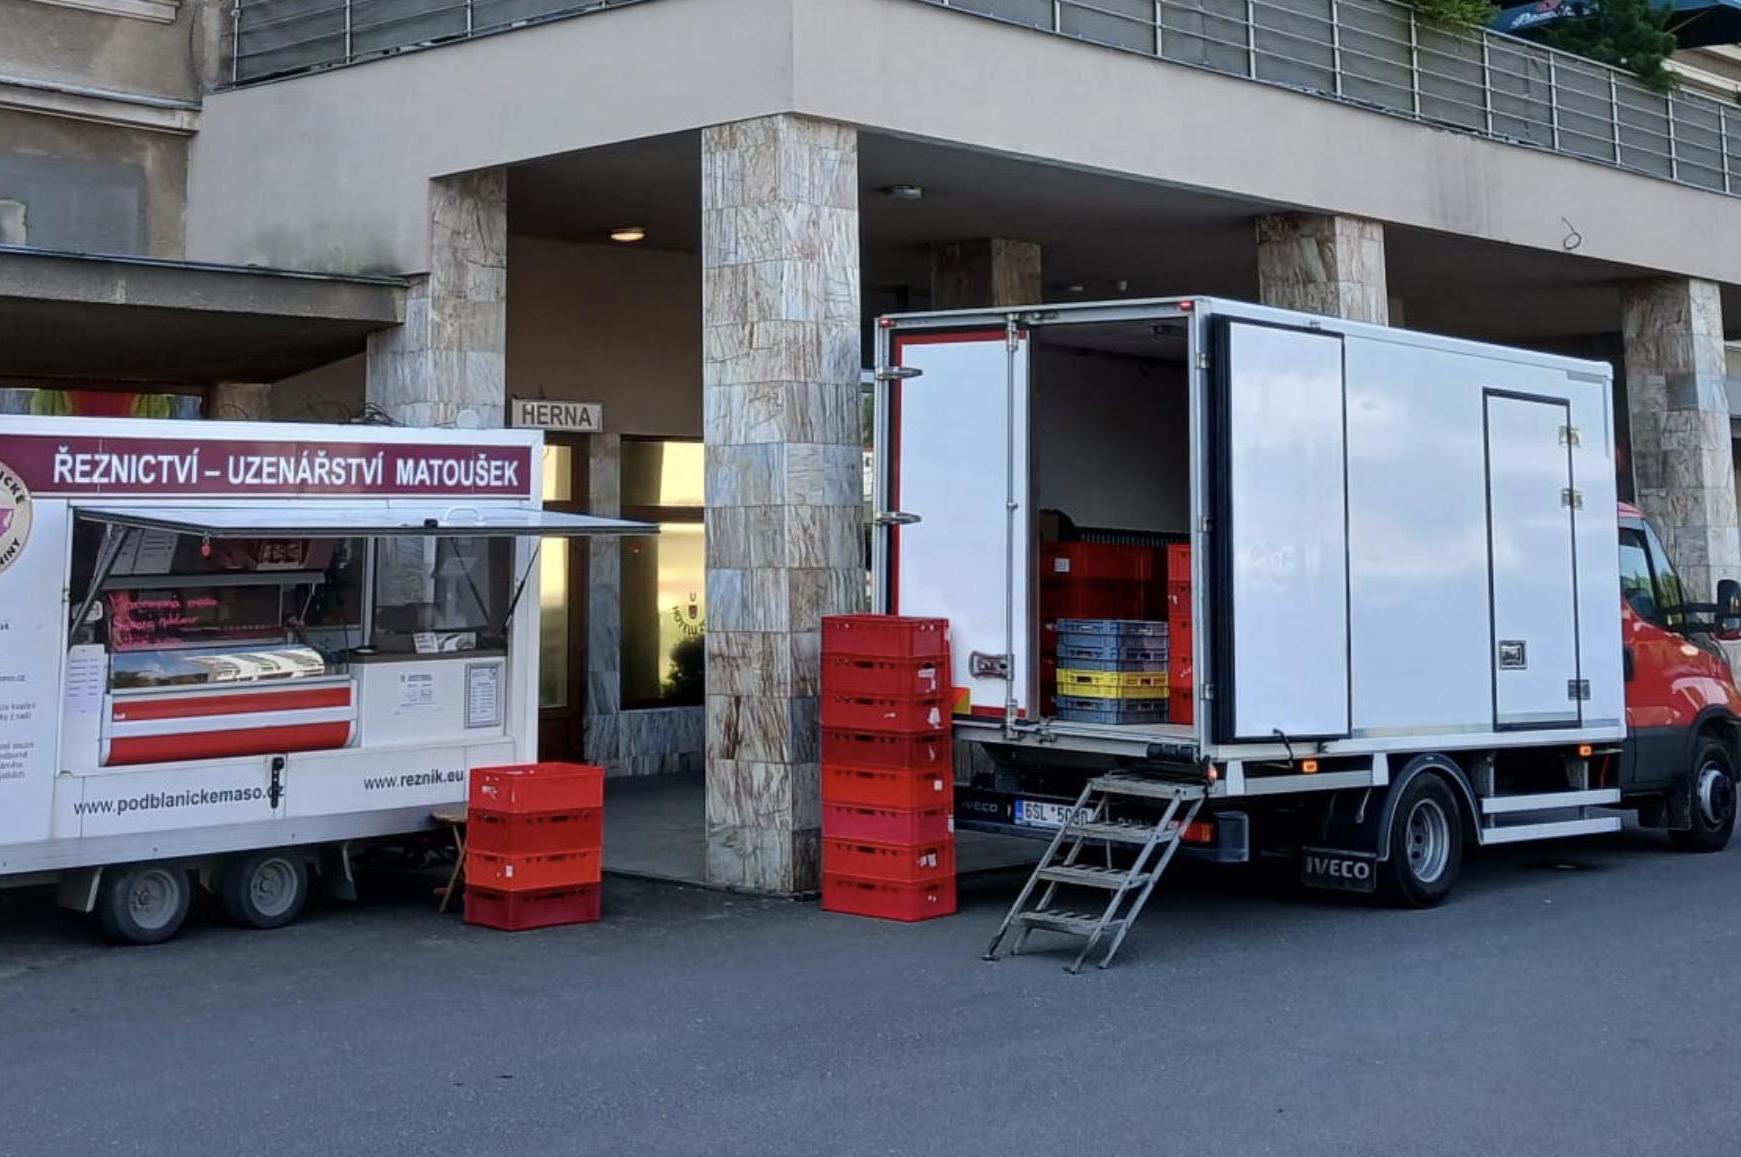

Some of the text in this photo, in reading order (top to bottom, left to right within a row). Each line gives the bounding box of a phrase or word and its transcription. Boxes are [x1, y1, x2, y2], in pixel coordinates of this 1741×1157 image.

[522, 404, 592, 426] HERNA
[53, 445, 199, 484] ŘEZNICTVÍ
[228, 449, 385, 485] UZENÁŘSTVÍ
[396, 453, 519, 487] MATOUŠEK
[363, 768, 464, 790] www.reznik.eu
[1024, 803, 1048, 822] 6SL
[1306, 856, 1370, 880] IVECO
